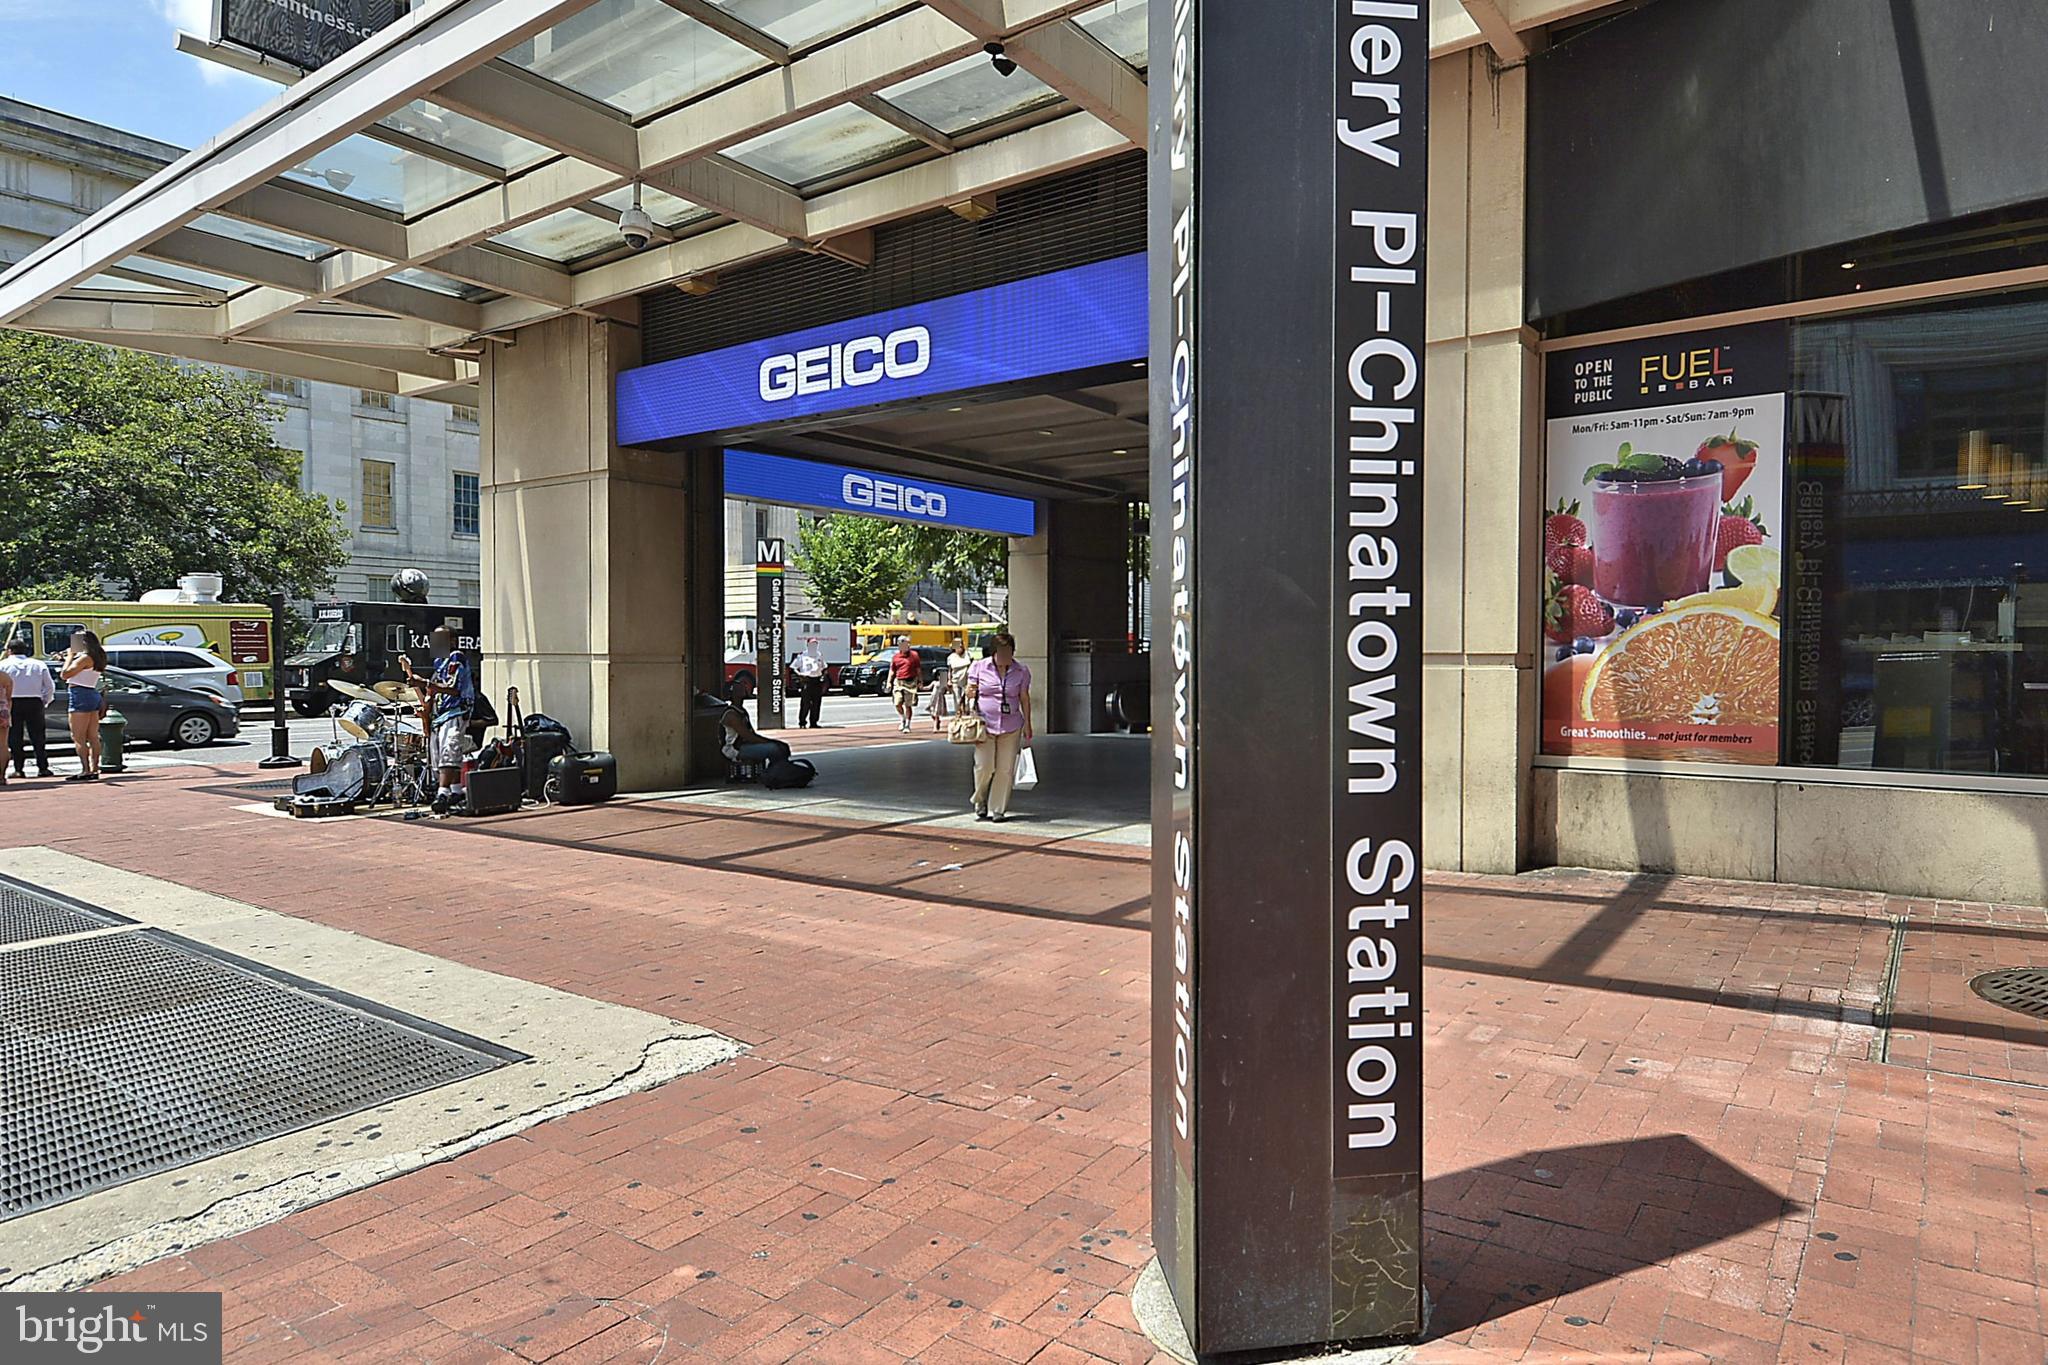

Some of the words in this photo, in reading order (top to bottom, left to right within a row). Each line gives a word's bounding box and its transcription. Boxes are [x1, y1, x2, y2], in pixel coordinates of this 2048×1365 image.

[759, 325, 931, 402] GEICO
[1574, 359, 1613, 376] OPEN
[1640, 348, 1734, 384] FUEL
[1574, 379, 1588, 390] TO
[1593, 375, 1613, 387] THE
[1574, 389, 1613, 405] PUBLIC
[1689, 375, 1733, 390] BAR
[1572, 422, 1609, 434] Mon/Fri:
[1610, 415, 1659, 432] 5am-11pm
[1665, 411, 1706, 425] Sat/Sun:
[1707, 406, 1755, 422] 7am-9pm
[842, 473, 947, 518] GEICO
[1347, 210, 1417, 793] Pl-Chinatown
[757, 540, 780, 562] M
[770, 578, 781, 612] Gallery
[772, 679, 782, 713] Station
[1560, 726, 1588, 738] Great
[1590, 727, 1646, 740] Smoothies
[1658, 733, 1674, 742] not
[1674, 733, 1693, 743] just
[1694, 733, 1708, 742] for
[1709, 734, 1753, 744] members
[1174, 830, 1191, 1140] Station
[1346, 837, 1415, 1148] Station
